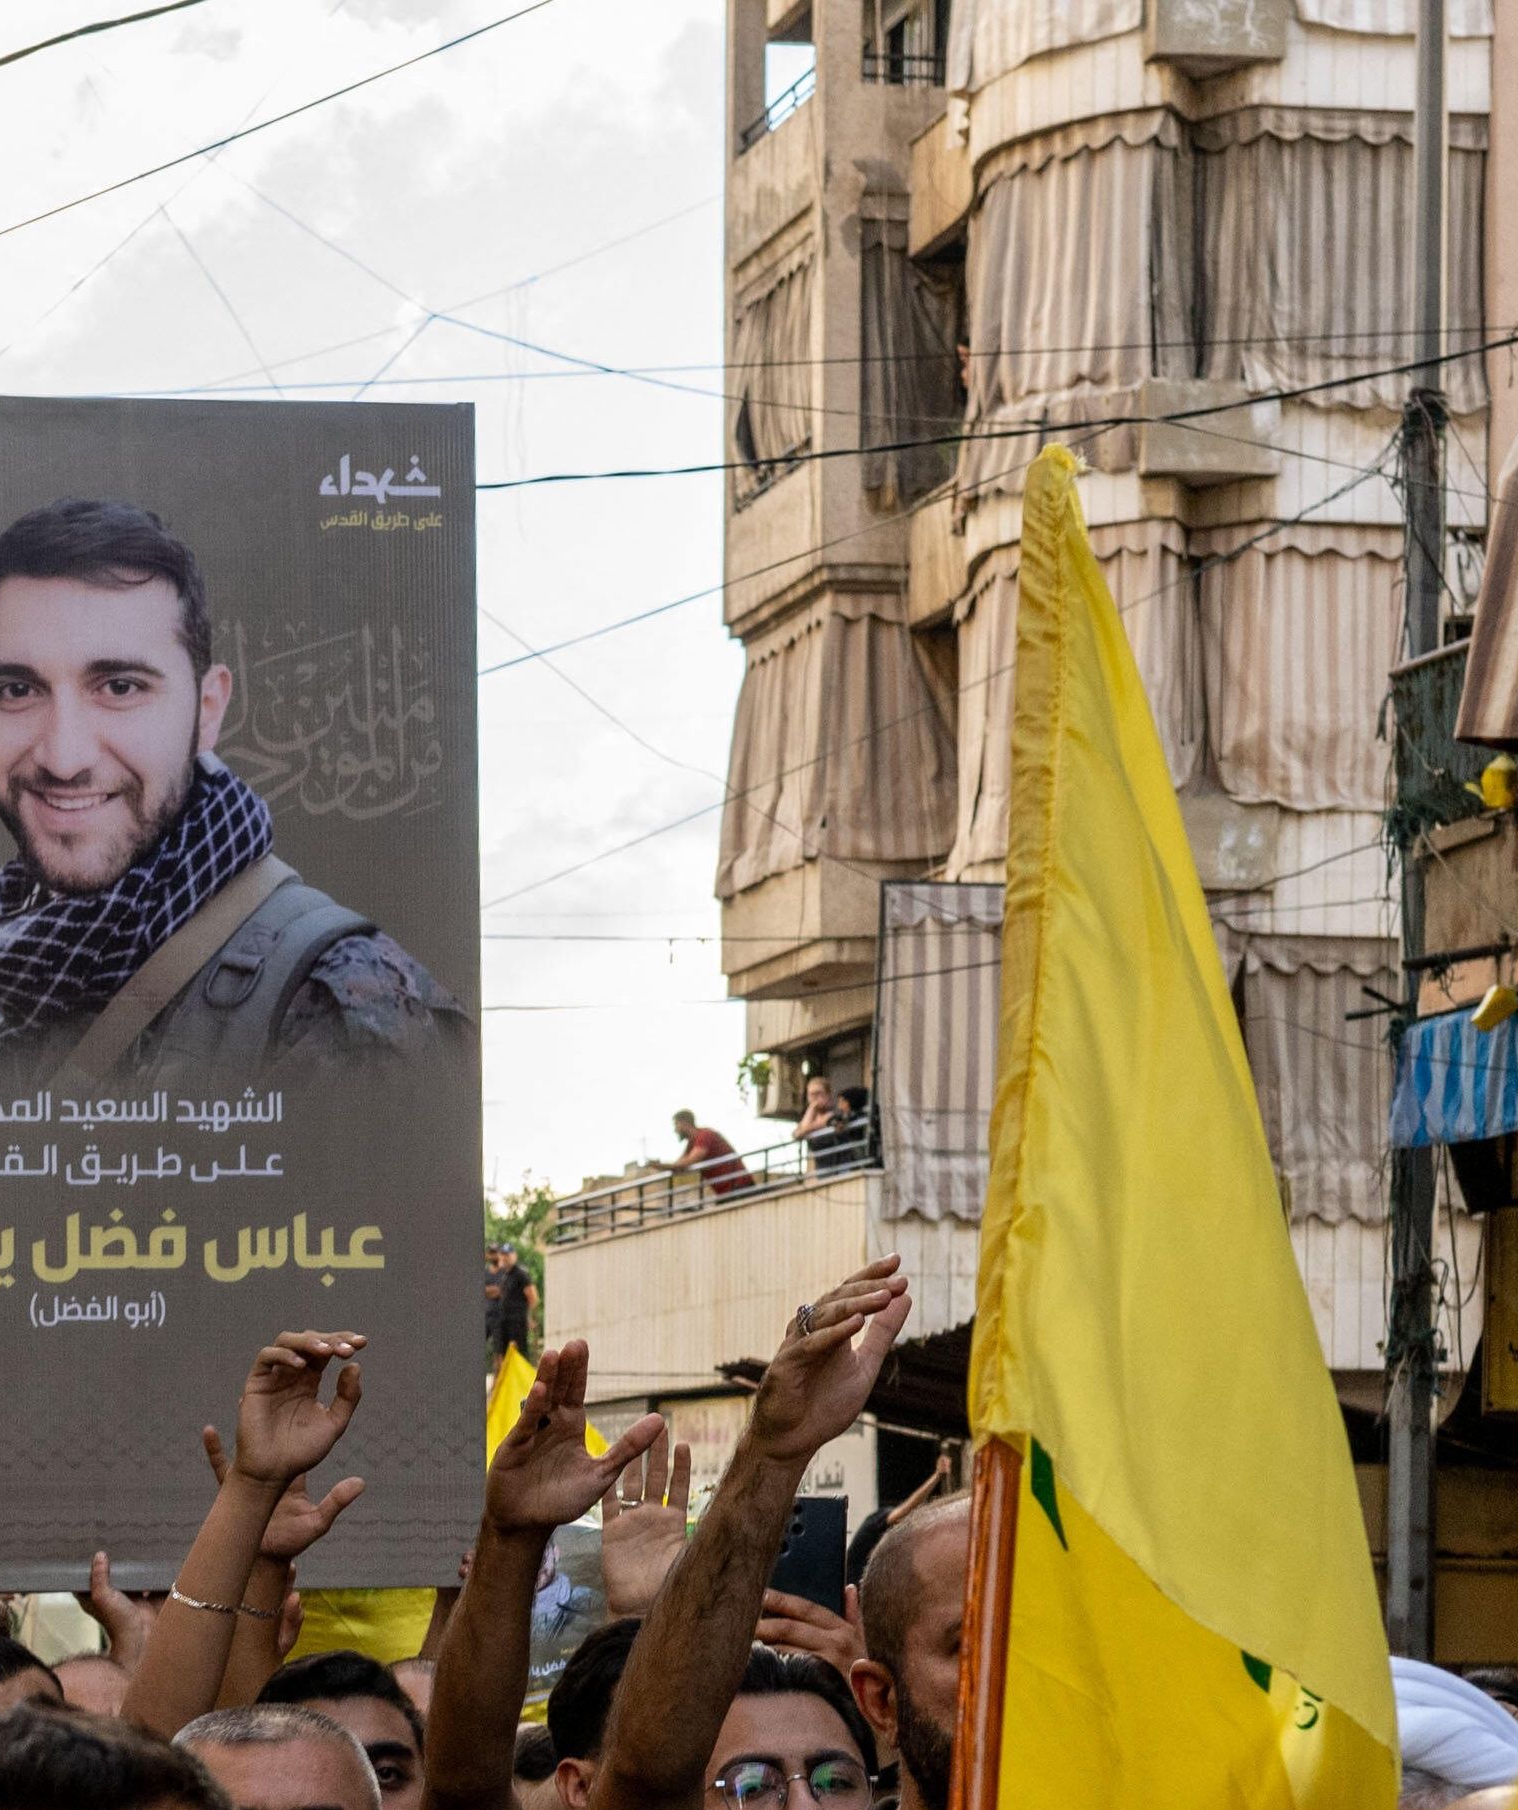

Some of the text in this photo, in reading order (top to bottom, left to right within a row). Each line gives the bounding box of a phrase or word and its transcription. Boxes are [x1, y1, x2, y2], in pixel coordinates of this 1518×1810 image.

[319, 453, 441, 504] شهداء
[319, 509, 442, 531] على طريق القدس
[59, 1090, 168, 1132] السعيد
[176, 1087, 283, 1132] الشهيد
[65, 1146, 183, 1186] طريق
[190, 1147, 284, 1183] على
[32, 1208, 188, 1285] فضل
[203, 1210, 386, 1288] عباس
[28, 1292, 167, 1330] (أبو الفضل)
